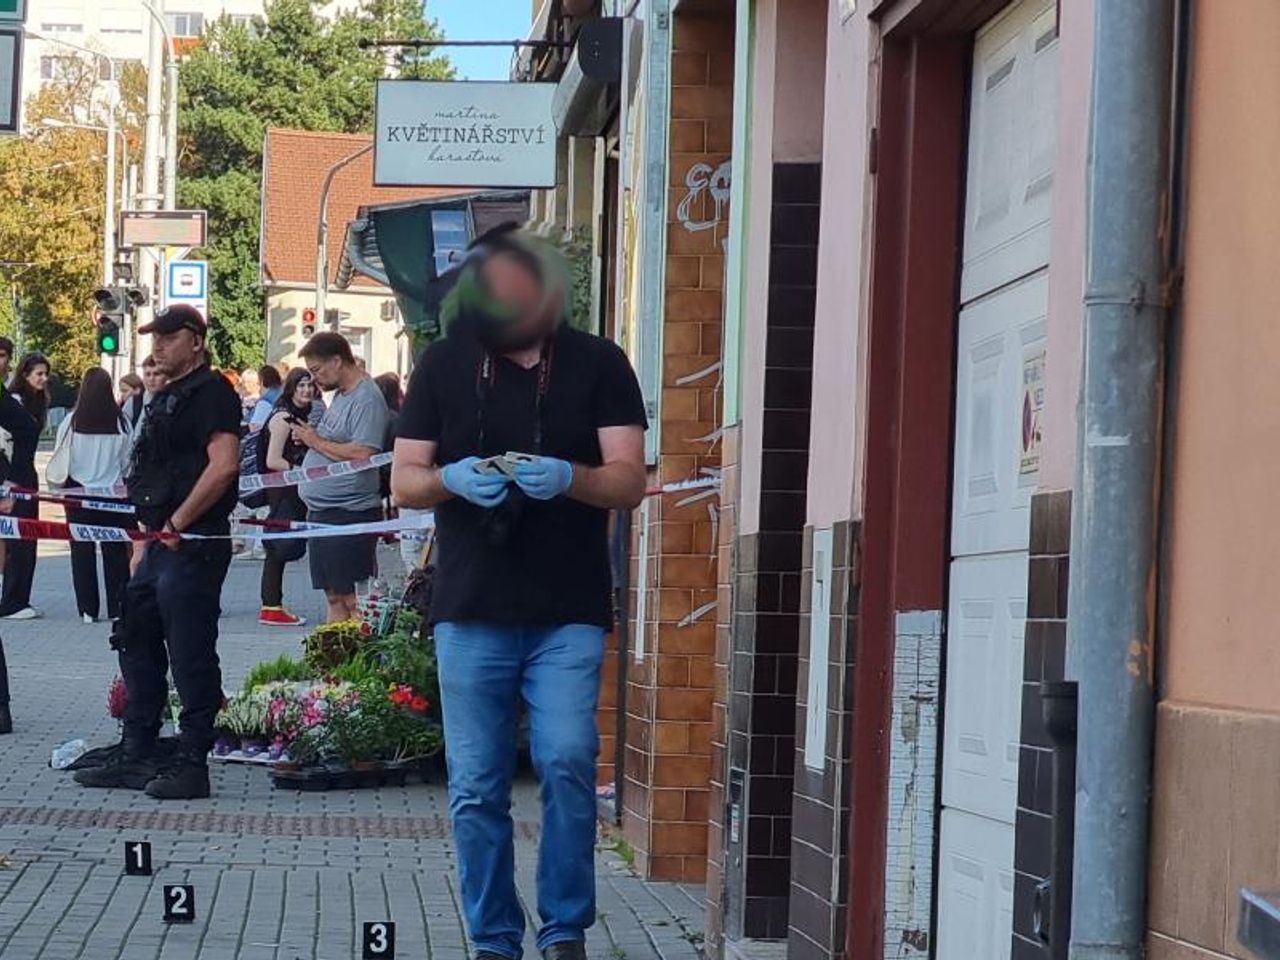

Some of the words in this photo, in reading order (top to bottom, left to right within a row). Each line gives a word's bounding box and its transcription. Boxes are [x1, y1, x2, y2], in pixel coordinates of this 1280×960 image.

[434, 105, 501, 120] martina
[386, 123, 546, 145] KVĚTINÁŘSTVÍ
[132, 843, 143, 868] 1
[169, 886, 188, 914] 2
[369, 923, 388, 954] 3
